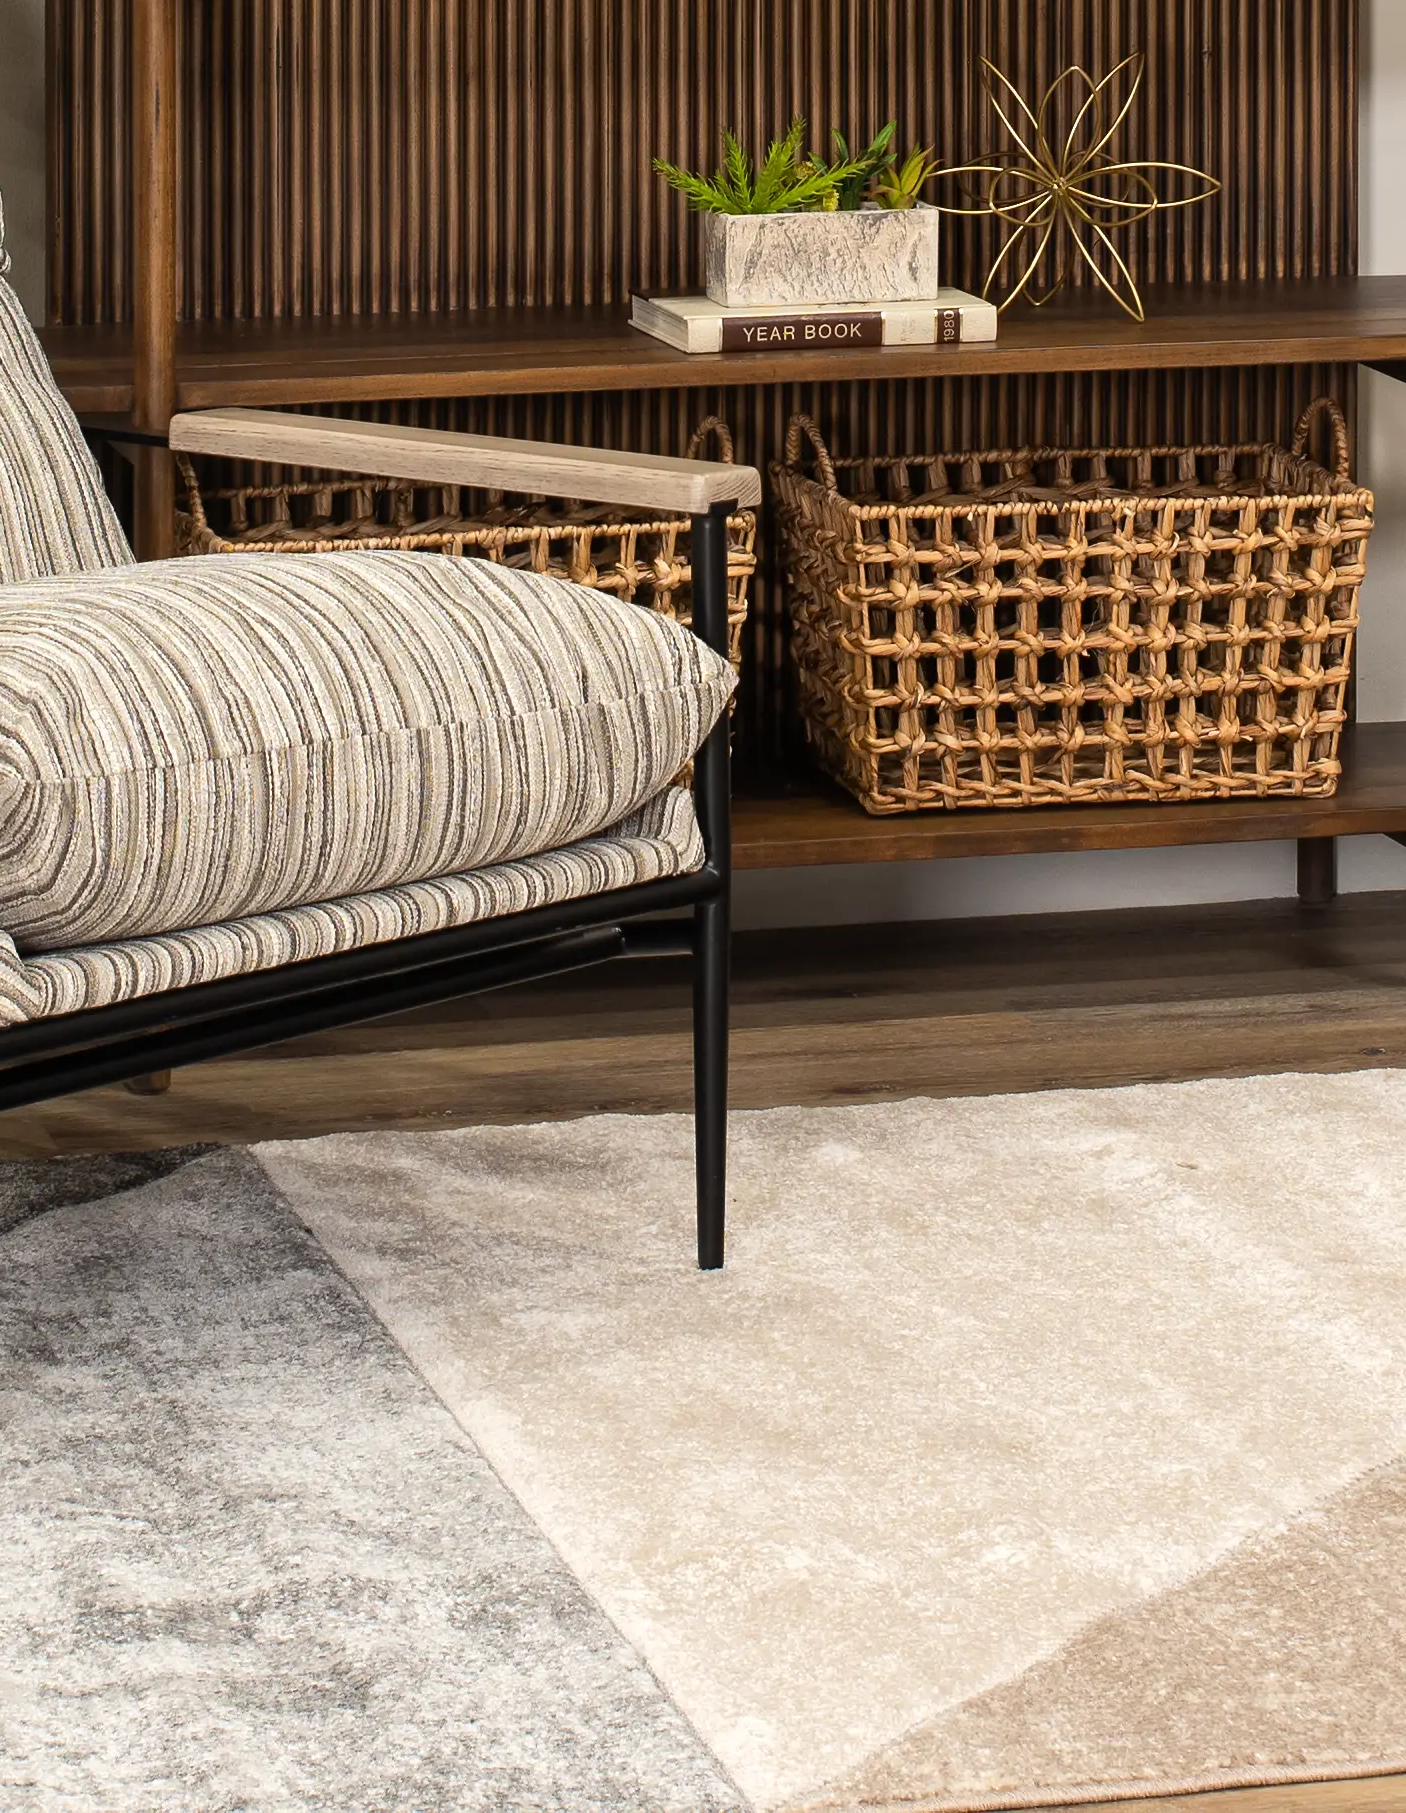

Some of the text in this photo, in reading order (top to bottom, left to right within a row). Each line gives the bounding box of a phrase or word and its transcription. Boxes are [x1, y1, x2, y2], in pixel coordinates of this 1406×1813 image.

[743, 322, 862, 343] YEAR BOOK
[943, 310, 955, 342] 1980
